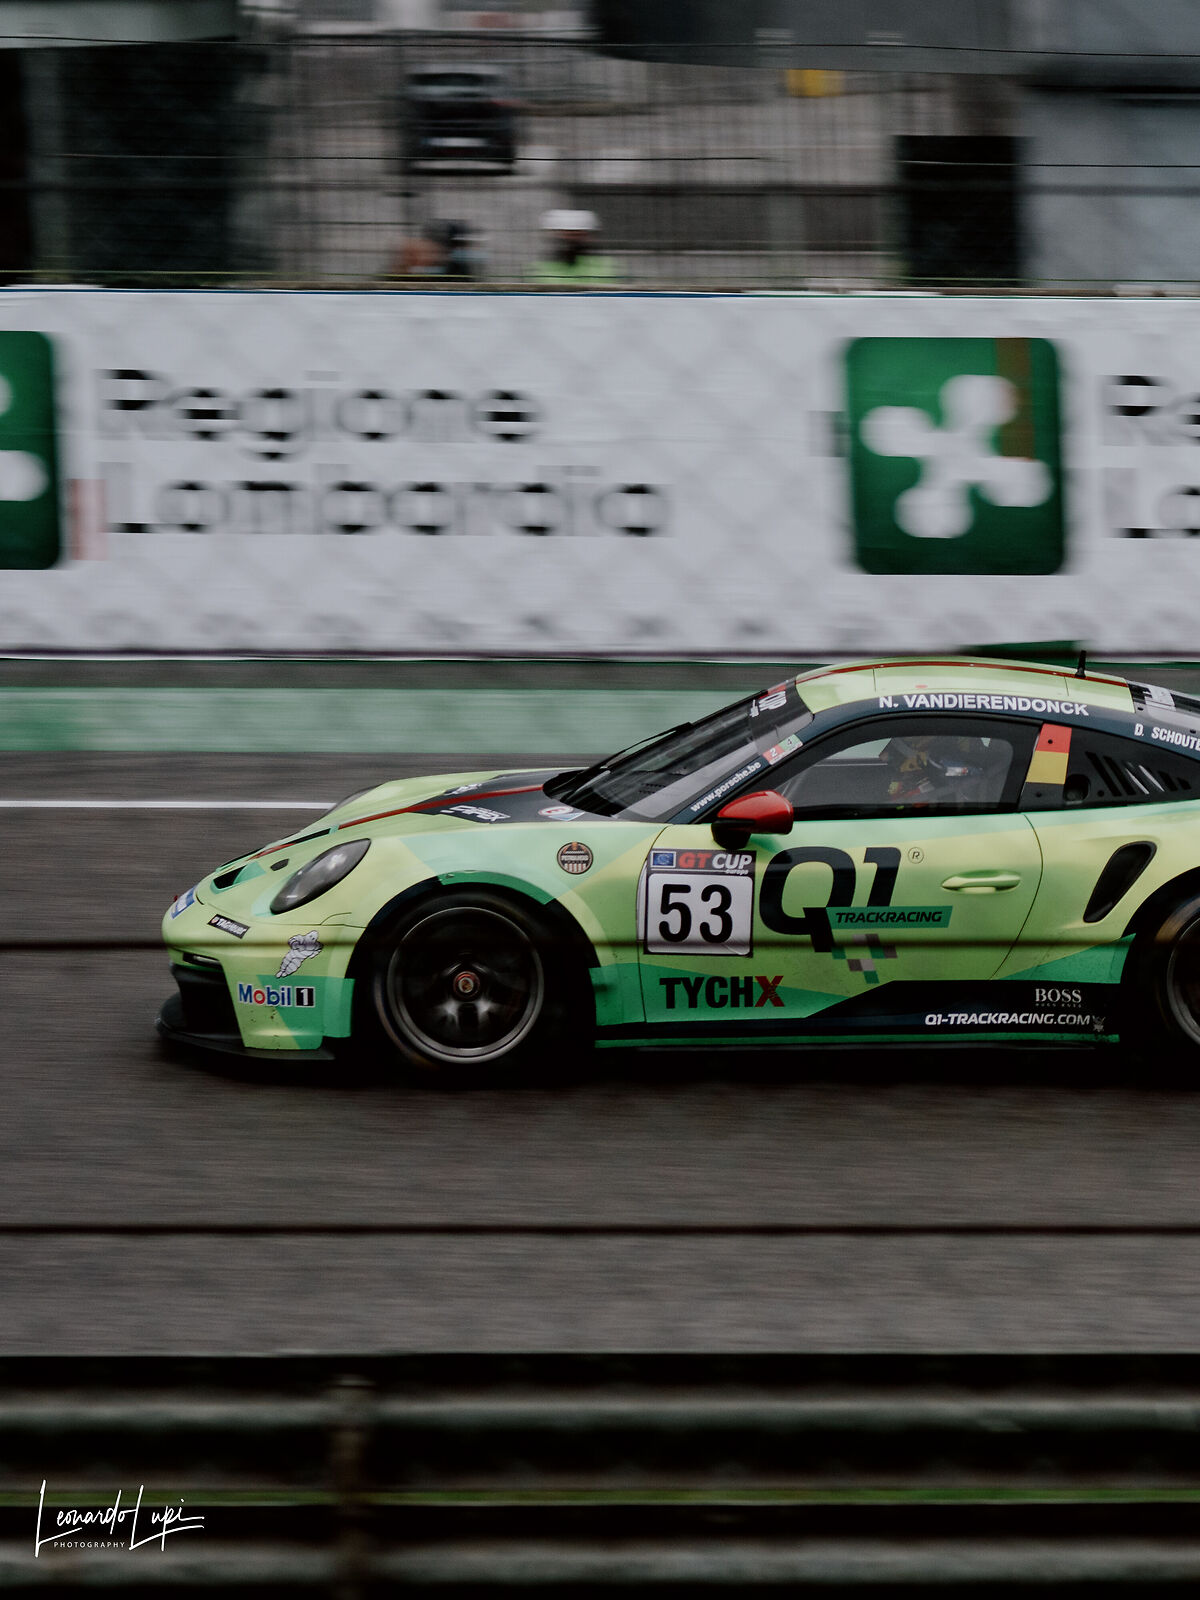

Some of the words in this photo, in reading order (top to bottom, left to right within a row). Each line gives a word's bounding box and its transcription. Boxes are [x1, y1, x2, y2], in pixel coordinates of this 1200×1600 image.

[100, 368, 542, 461] Regione
[879, 696, 899, 708] N.
[903, 694, 1089, 716] VANDIERENDONCK
[1134, 723, 1145, 737] D.
[690, 761, 762, 812] www.porsche.be
[678, 852, 712, 868] GT
[712, 853, 752, 869] CUP
[759, 846, 902, 953] Q1
[659, 884, 733, 943] 53
[836, 911, 942, 924] TRACKRACING
[238, 983, 292, 1006] Mobil
[298, 988, 311, 1006] 1
[659, 975, 785, 1009] TYCHX
[1035, 988, 1082, 1003] BOSS
[925, 1013, 1090, 1025] Q1-TRACKRACING.COM
